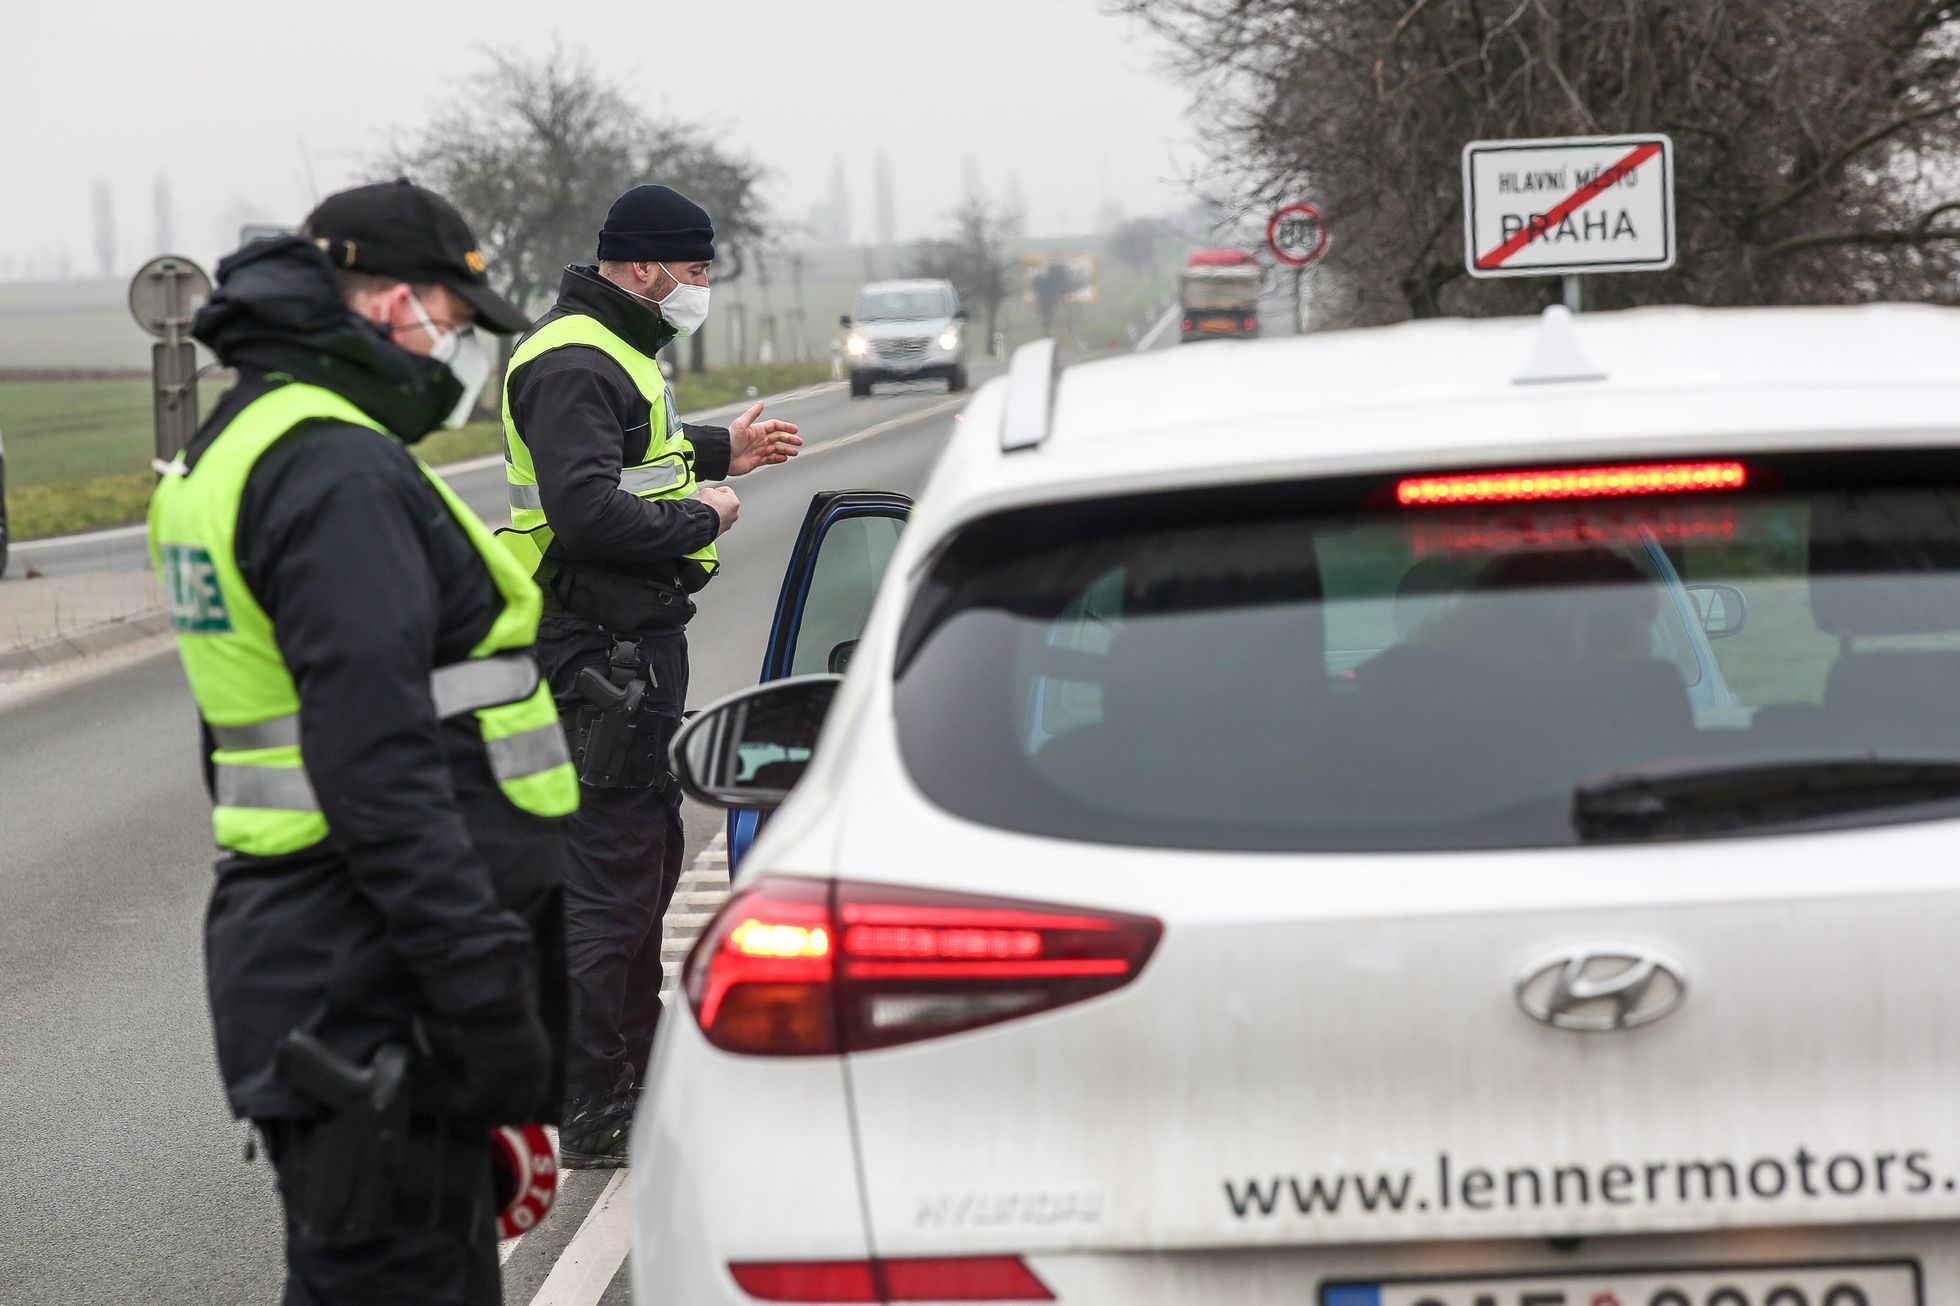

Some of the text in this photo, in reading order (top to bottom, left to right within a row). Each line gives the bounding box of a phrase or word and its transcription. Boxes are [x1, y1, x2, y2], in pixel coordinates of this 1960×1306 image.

[1498, 164, 1567, 193] HLAVNÍ
[1501, 210, 1637, 246] PRAHA
[497, 1154, 556, 1239] STO
[1224, 1145, 1956, 1217] www.lennermotors.
